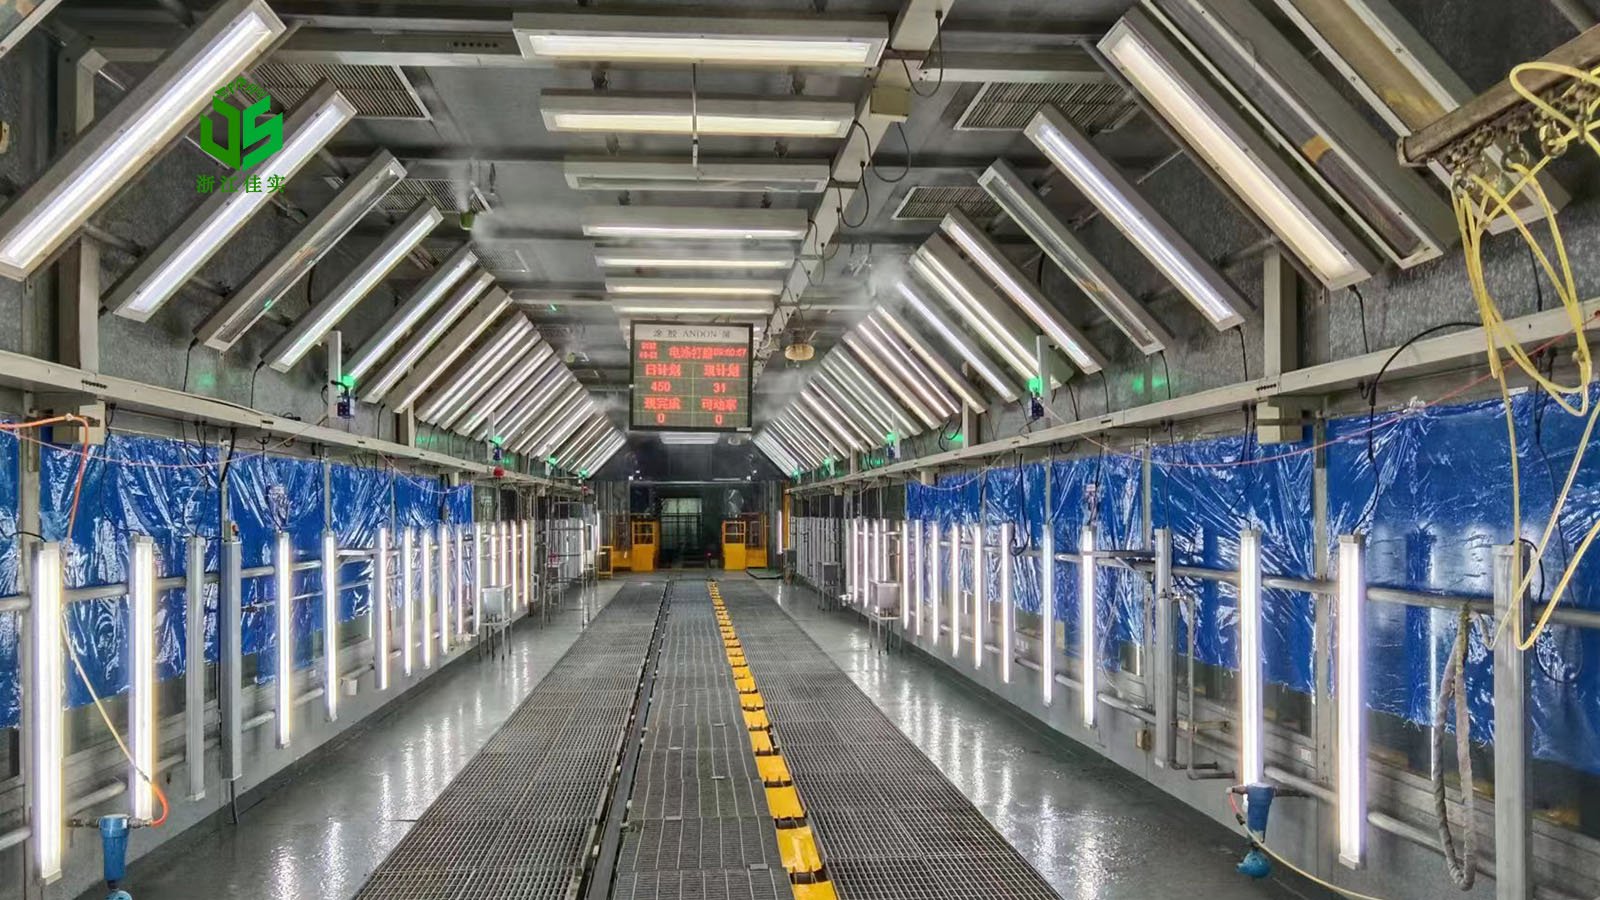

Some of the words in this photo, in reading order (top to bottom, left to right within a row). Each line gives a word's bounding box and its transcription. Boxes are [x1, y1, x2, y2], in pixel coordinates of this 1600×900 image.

[683, 330, 717, 338] ANDON
[645, 363, 681, 377] 日计划
[713, 382, 726, 393] 31
[657, 413, 665, 423] 0
[715, 414, 723, 425] 0
